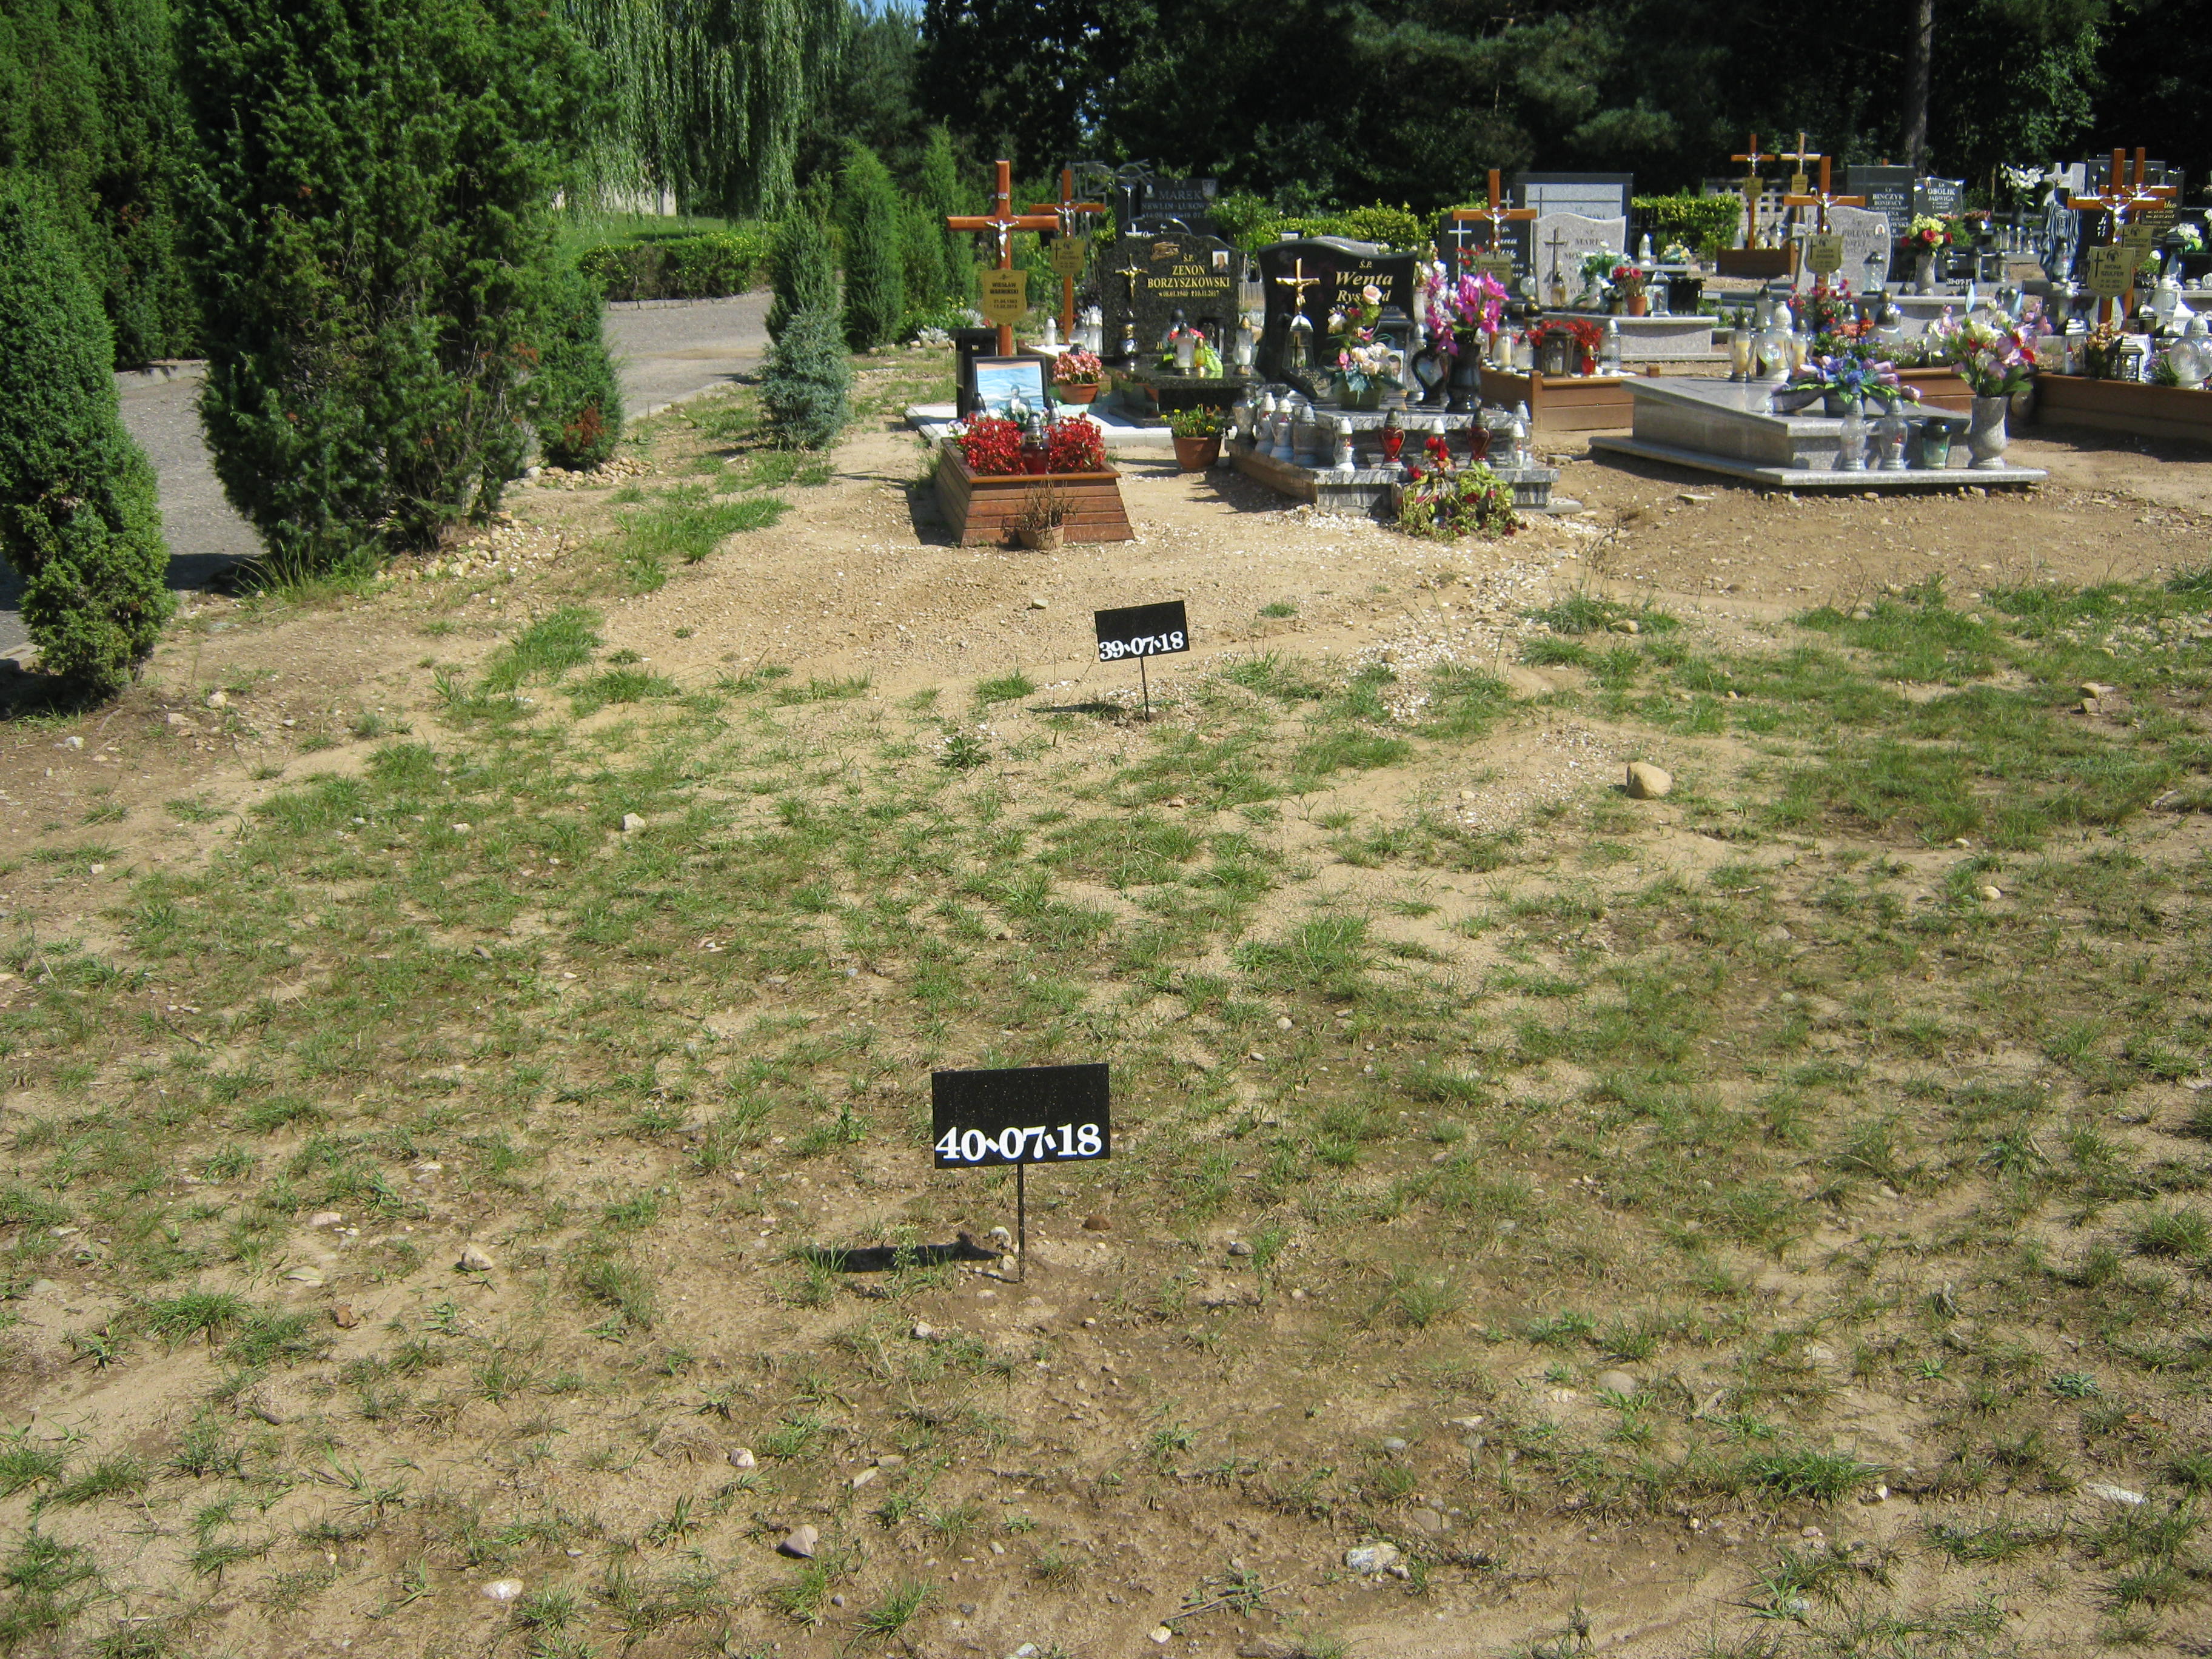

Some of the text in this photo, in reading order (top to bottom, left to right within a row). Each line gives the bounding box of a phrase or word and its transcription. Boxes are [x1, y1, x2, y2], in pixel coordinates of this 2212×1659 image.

[1159, 190, 1202, 200] MAREK
[1172, 265, 1205, 275] ZENON
[1147, 277, 1230, 288] BORZYSZKOWSKI
[1335, 271, 1393, 285] Wenta
[1336, 290, 1392, 304] Rysd
[1099, 631, 1184, 660] 39-07-18
[935, 1123, 1102, 1162] 40-07-18
